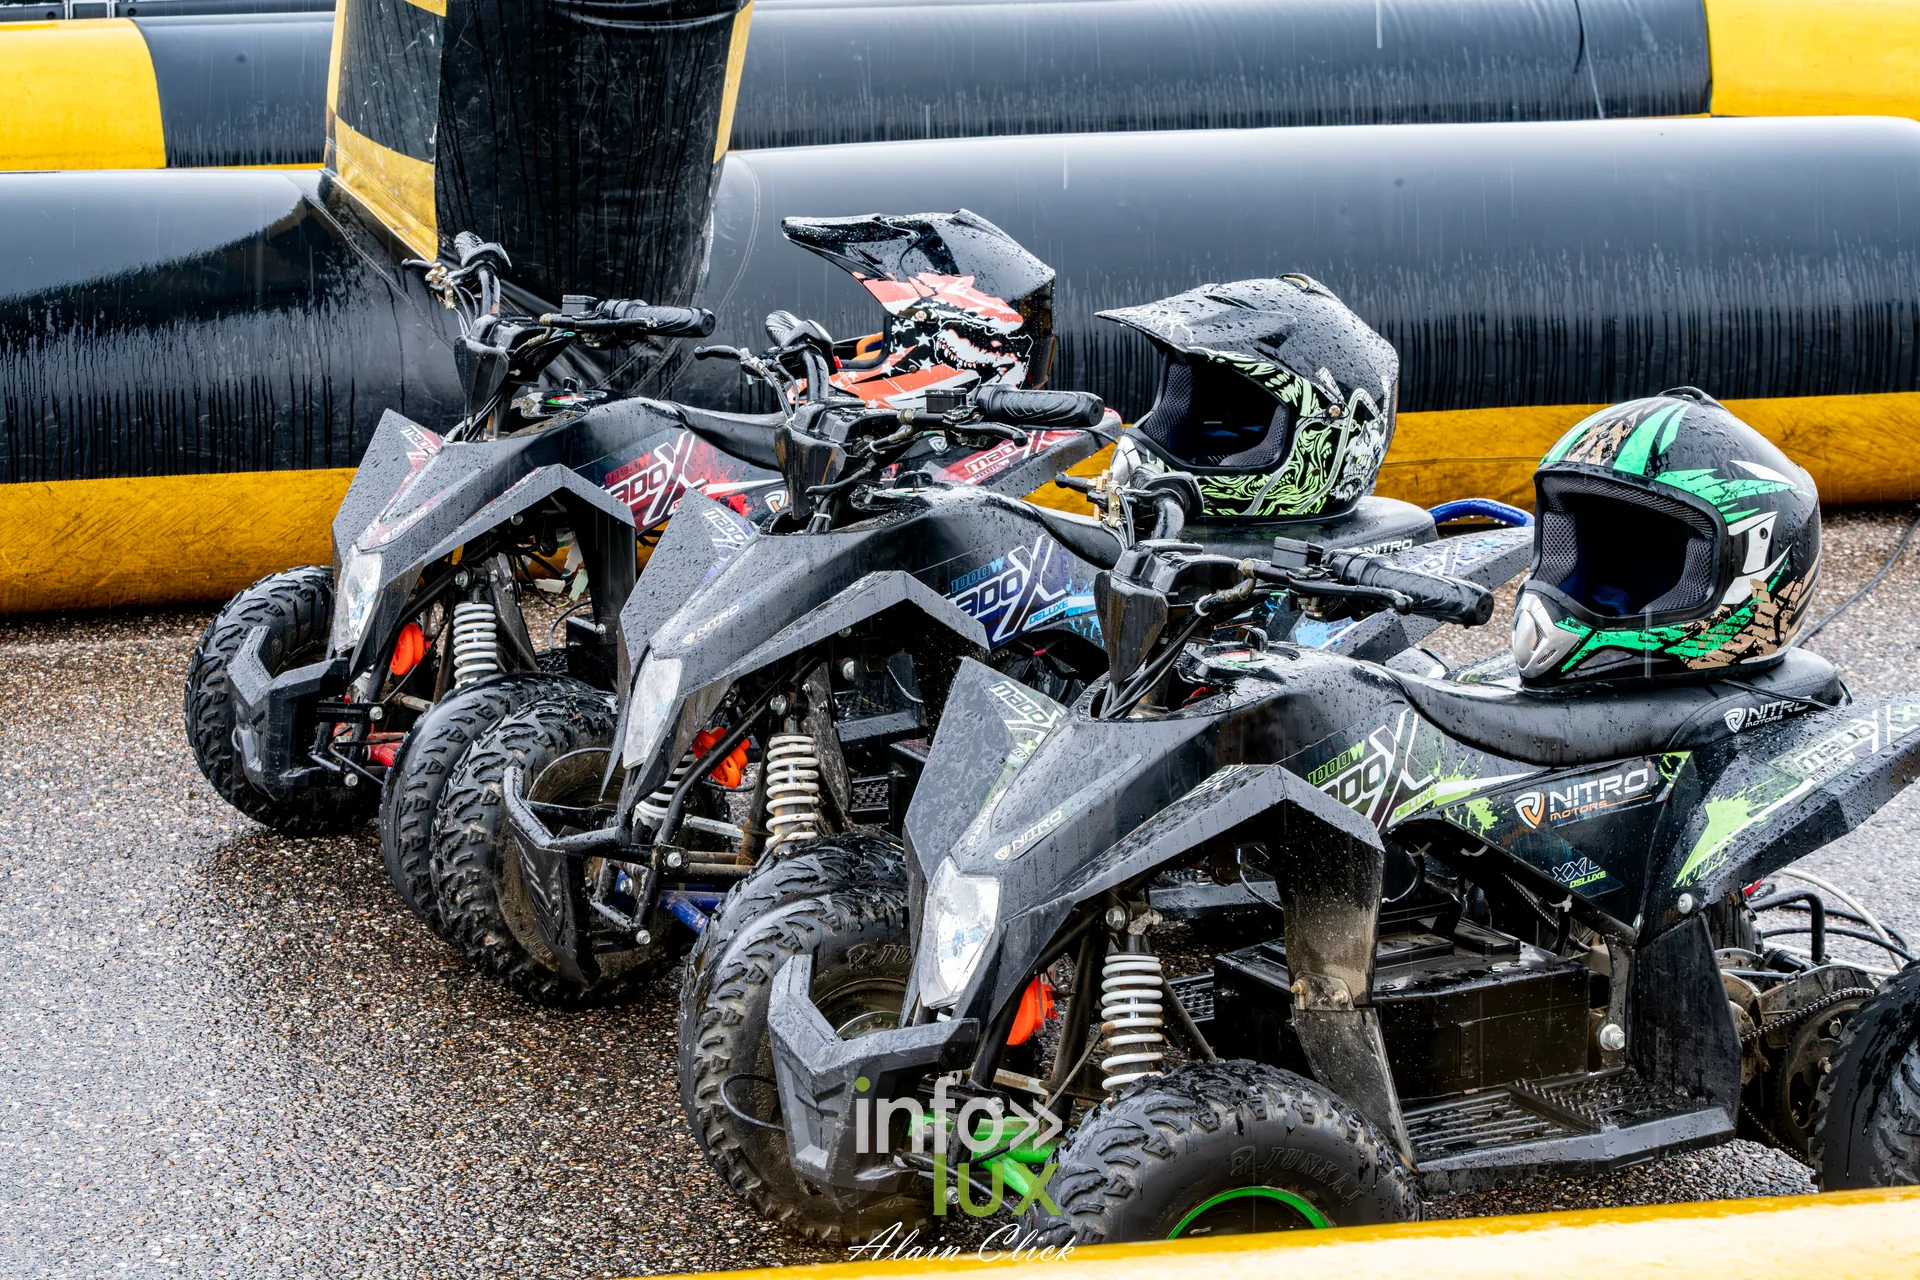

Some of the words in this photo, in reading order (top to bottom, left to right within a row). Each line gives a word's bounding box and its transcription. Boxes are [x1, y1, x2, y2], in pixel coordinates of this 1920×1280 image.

[951, 556, 1005, 594] 1000W
[1029, 600, 1069, 625] DELUXE
[1745, 714, 1784, 728] MOTORS
[1308, 740, 1365, 786] 1000W
[1393, 785, 1438, 819] DELUXE
[1550, 768, 1649, 812] NITRO
[1550, 800, 1608, 822] MOTORS
[1012, 809, 1063, 852] NITRO
[1552, 857, 1601, 883] XXL
[1569, 870, 1607, 889] DELUXE
